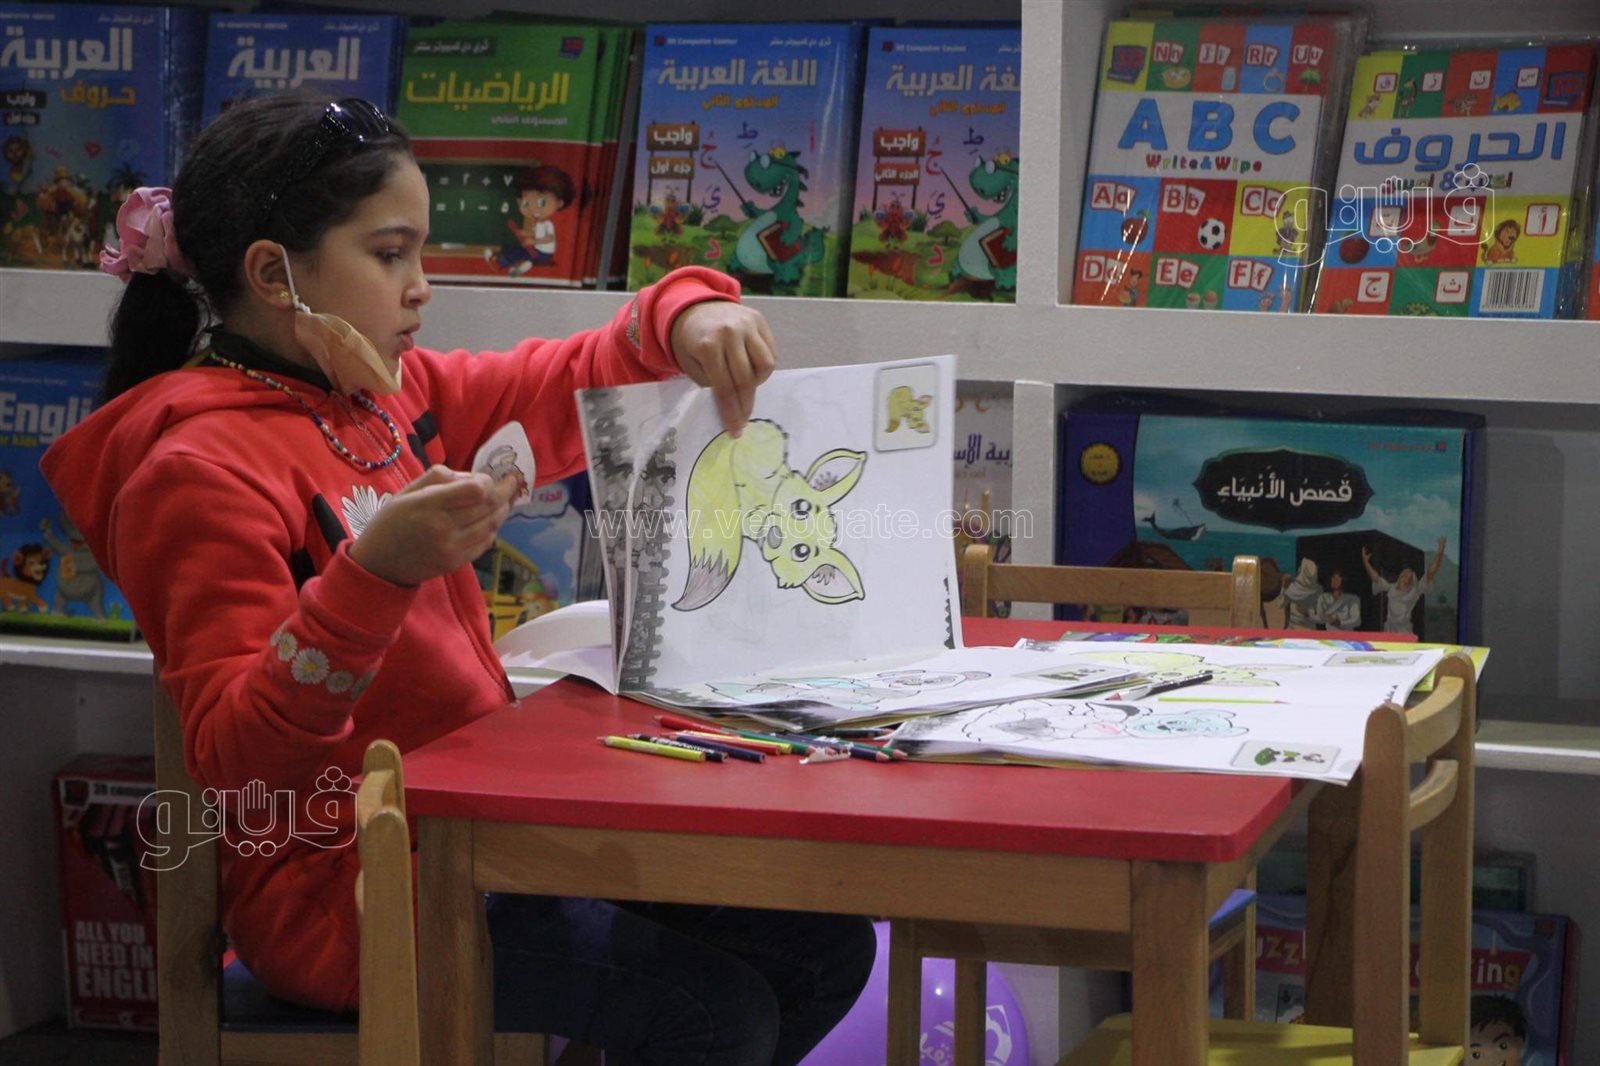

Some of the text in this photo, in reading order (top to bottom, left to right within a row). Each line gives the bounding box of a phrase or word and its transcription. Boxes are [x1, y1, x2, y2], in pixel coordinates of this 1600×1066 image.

[1, 26, 133, 80] العربية
[227, 36, 360, 89] العربية
[657, 58, 817, 90] اللغة العربية
[886, 64, 974, 96] العربية
[60, 80, 137, 109] حروف
[406, 71, 570, 111] الرياضيات
[653, 127, 693, 145] واجب
[880, 133, 920, 152] واجب
[1354, 122, 1567, 171] الحروف
[1166, 186, 1201, 211] Bb
[1159, 259, 1193, 284] Ee
[1233, 261, 1269, 286] Ff
[0, 391, 92, 444] Engli
[75, 920, 145, 945] ALL YOU
[75, 942, 154, 969] NEED IN
[78, 966, 158, 1001] ENGLI
